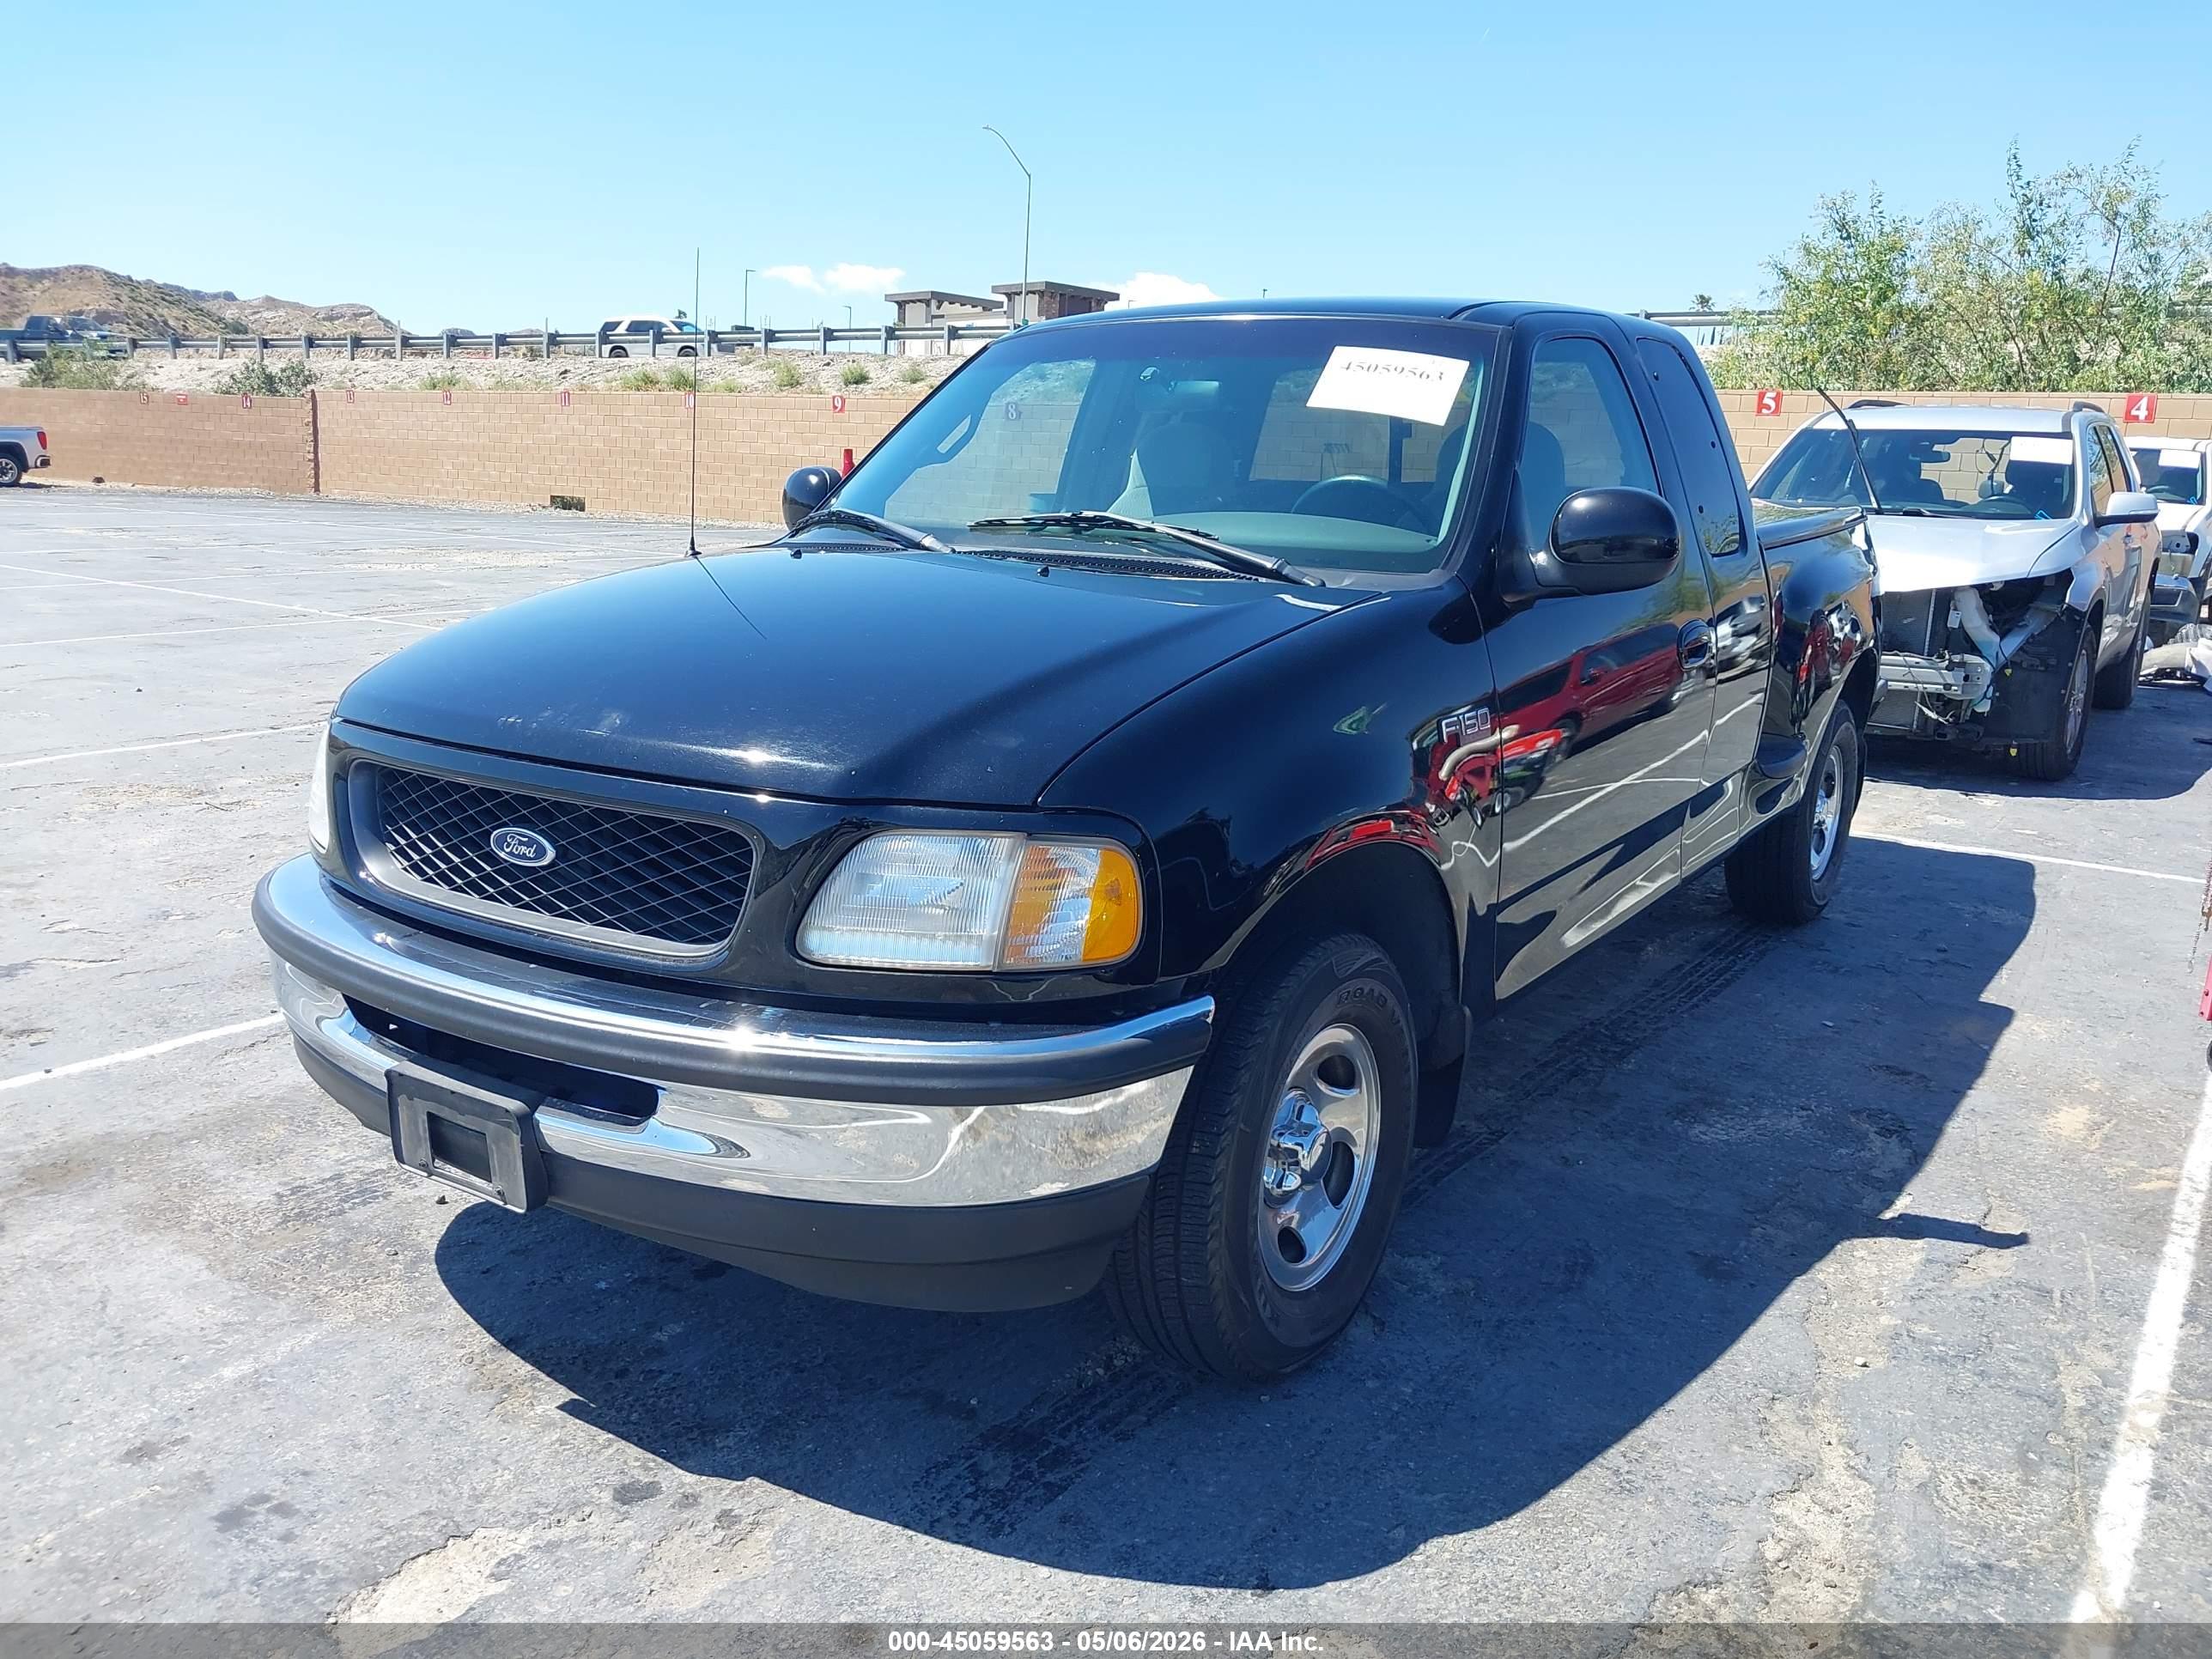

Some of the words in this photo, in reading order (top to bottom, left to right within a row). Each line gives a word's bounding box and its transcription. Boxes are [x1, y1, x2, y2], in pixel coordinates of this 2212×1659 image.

[141, 392, 148, 404] 15
[243, 396, 251, 408] 14
[562, 393, 569, 405] 11
[685, 393, 694, 408] 10
[836, 396, 842, 412] 9
[1762, 392, 1777, 414] 5
[1008, 404, 1016, 420] 8
[2130, 396, 2148, 420] 4
[503, 833, 537, 858] Ford
